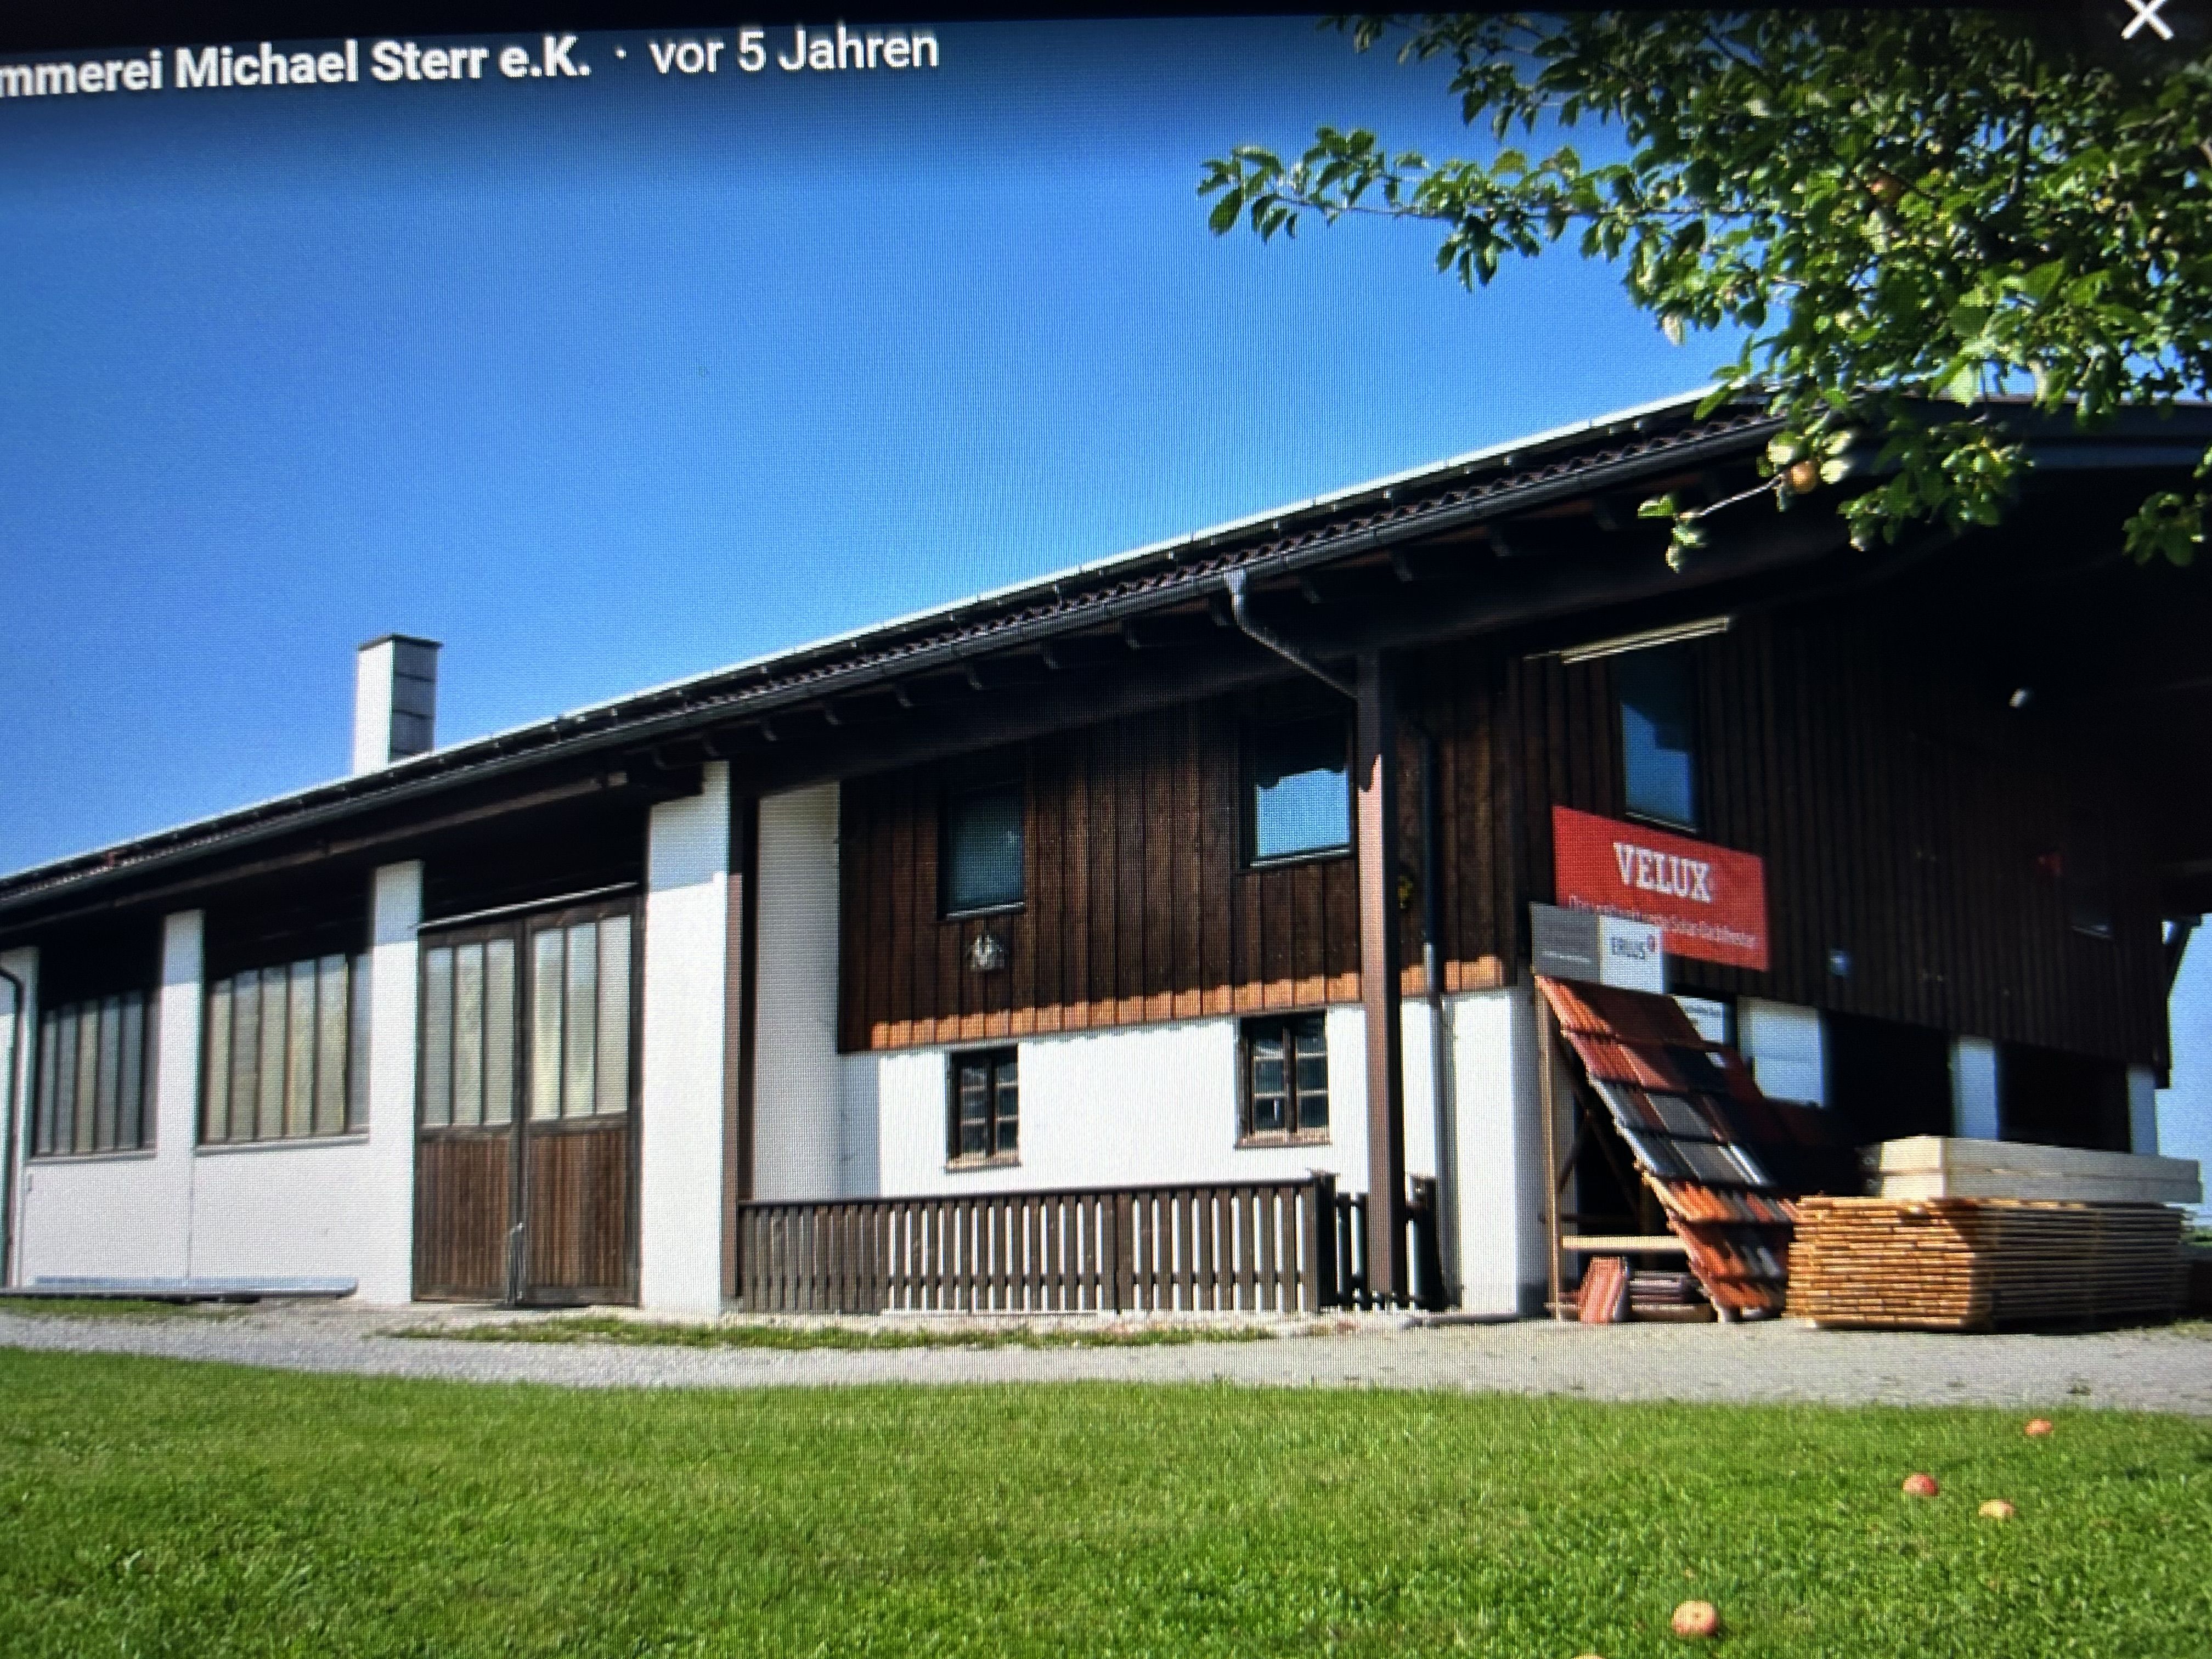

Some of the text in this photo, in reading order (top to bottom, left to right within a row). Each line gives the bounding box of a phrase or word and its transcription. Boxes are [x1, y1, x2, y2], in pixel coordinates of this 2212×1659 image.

[0, 22, 939, 98] mmerei Michael Sterr e.K. vor 5 Jahren
[1613, 842, 1713, 904] VELUX
